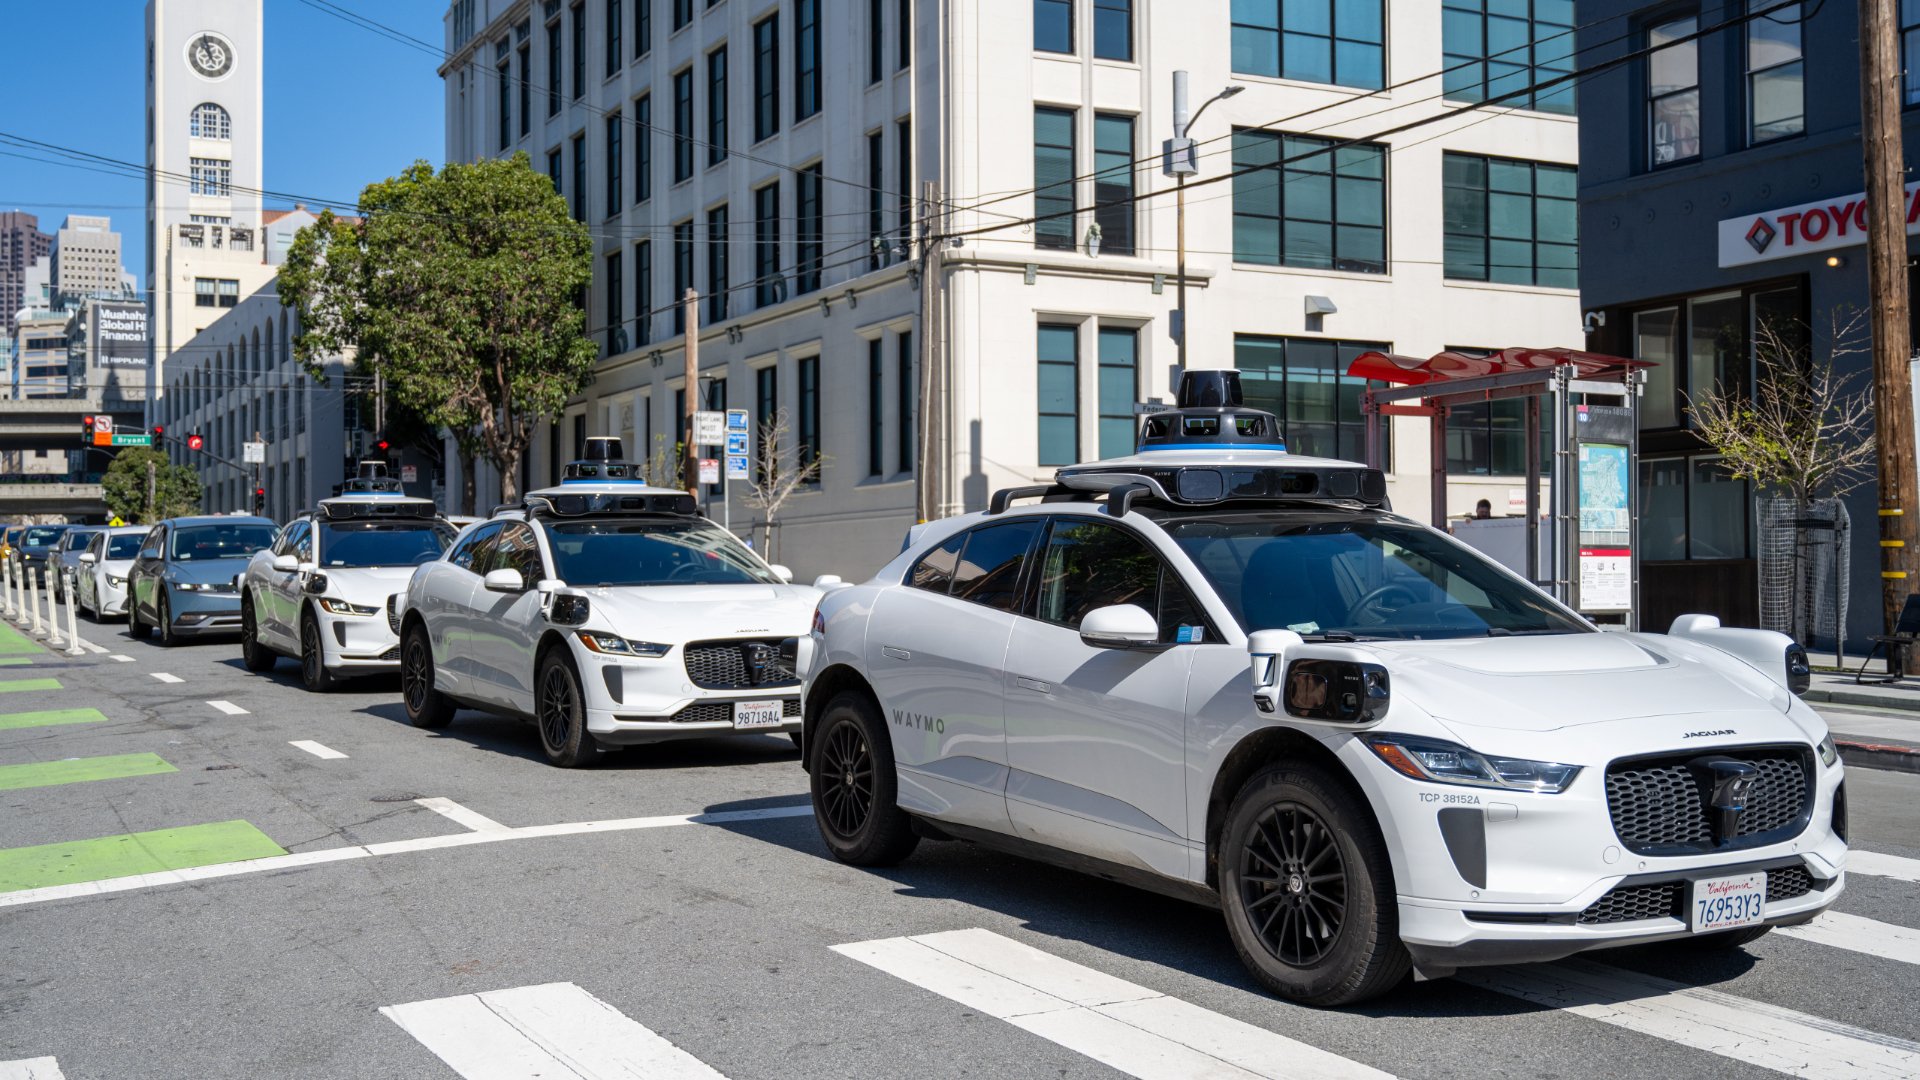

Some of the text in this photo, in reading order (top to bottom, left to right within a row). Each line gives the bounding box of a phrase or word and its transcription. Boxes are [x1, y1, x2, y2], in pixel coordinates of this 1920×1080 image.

[1777, 187, 1920, 247] TOY
[100, 320, 147, 332] Global H
[100, 330, 142, 341] Finance
[1580, 413, 1587, 421] 10
[117, 437, 146, 445] Bryant
[738, 710, 780, 725] 98718A4
[892, 708, 945, 735] WAYMO
[1682, 729, 1737, 739] JAGUAR
[1419, 792, 1481, 805] TCP 38152A
[1708, 881, 1753, 896] California
[1698, 893, 1762, 924] 76953Y3
